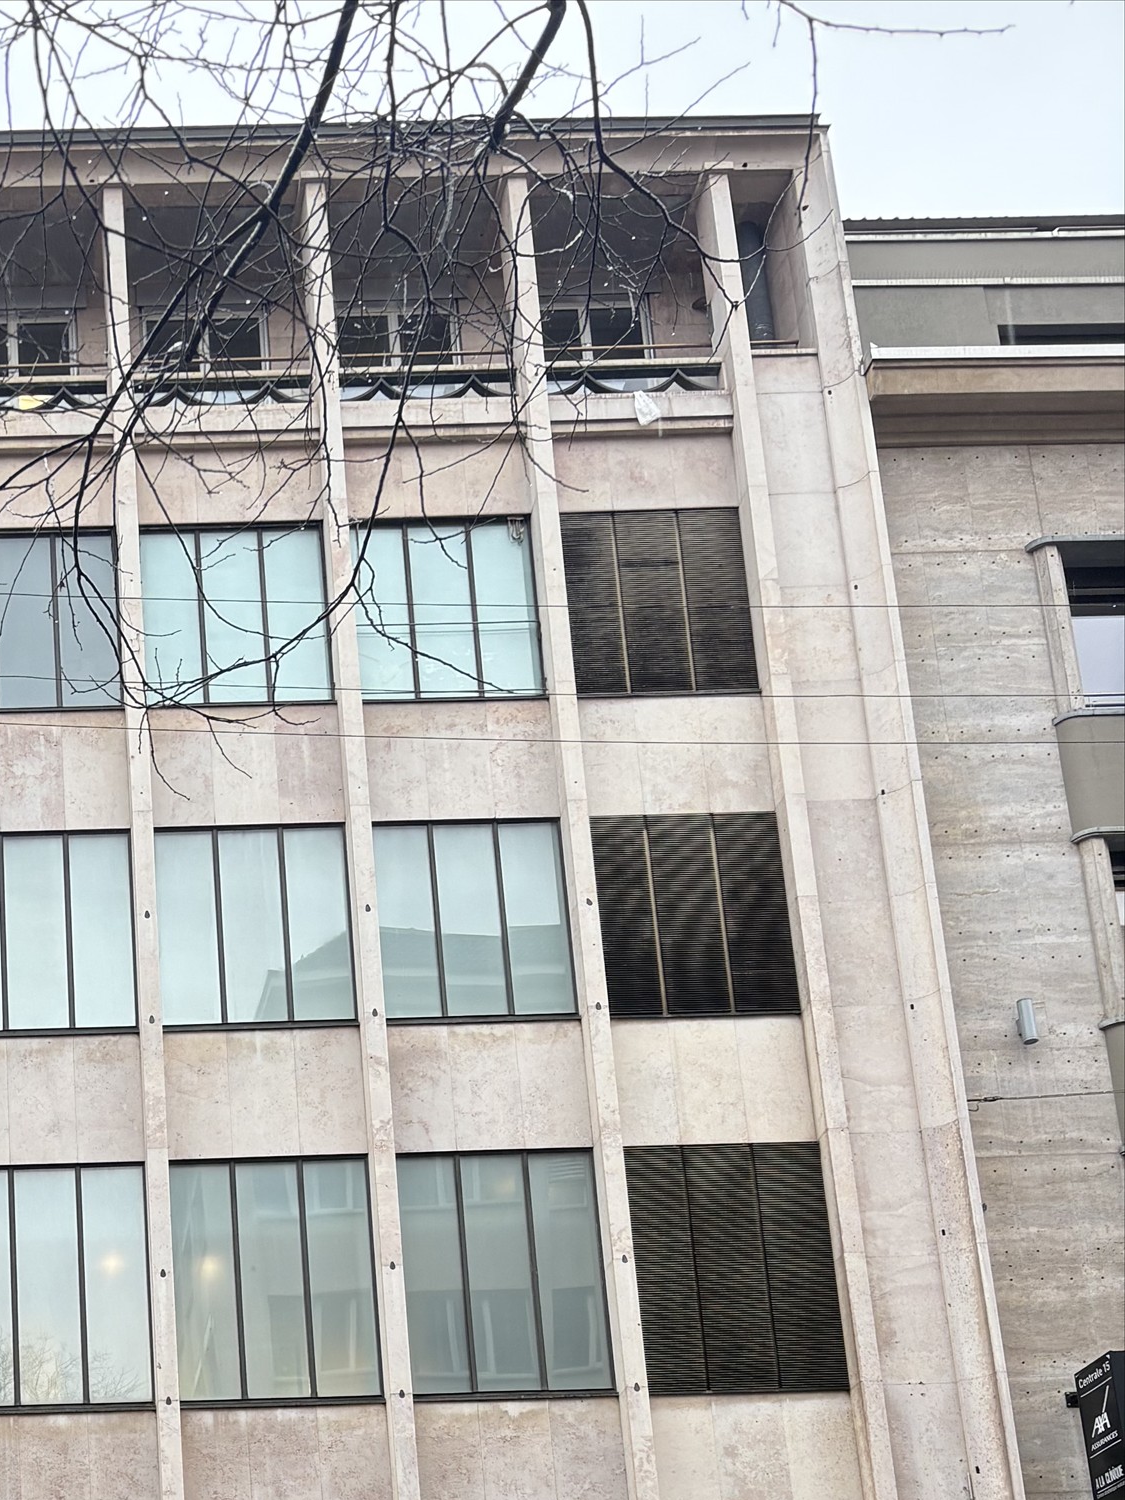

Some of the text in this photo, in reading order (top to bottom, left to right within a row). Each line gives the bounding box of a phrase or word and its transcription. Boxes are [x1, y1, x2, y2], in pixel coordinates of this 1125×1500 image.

[1079, 1360, 1111, 1389] Centrale 15
[1091, 1411, 1111, 1438] AXA
